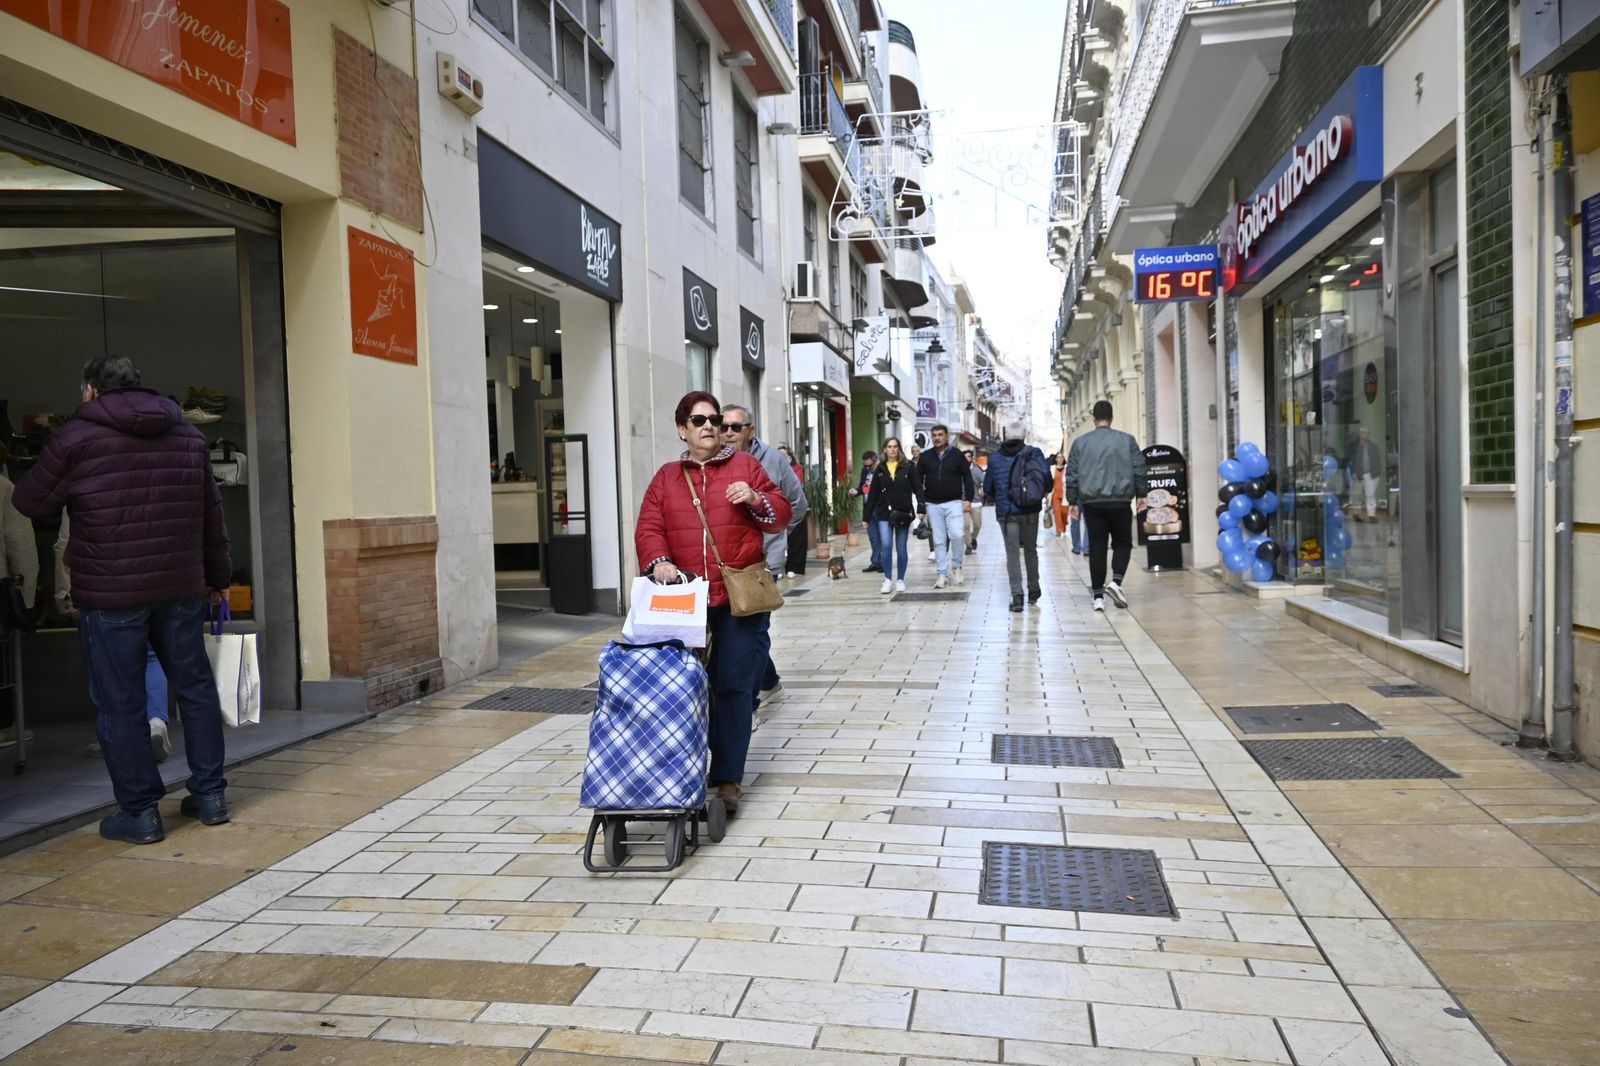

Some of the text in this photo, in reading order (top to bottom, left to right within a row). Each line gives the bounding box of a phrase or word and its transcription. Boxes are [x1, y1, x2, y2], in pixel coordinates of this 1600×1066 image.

[159, 48, 268, 113] ZAPATOS
[1237, 115, 1343, 259] óptica urbano
[581, 204, 616, 260] BRUTAL
[358, 237, 405, 260] ZAPATOS
[1137, 251, 1215, 267] óptica urbano
[586, 253, 609, 283] ZAPAS
[1148, 272, 1171, 298] 16
